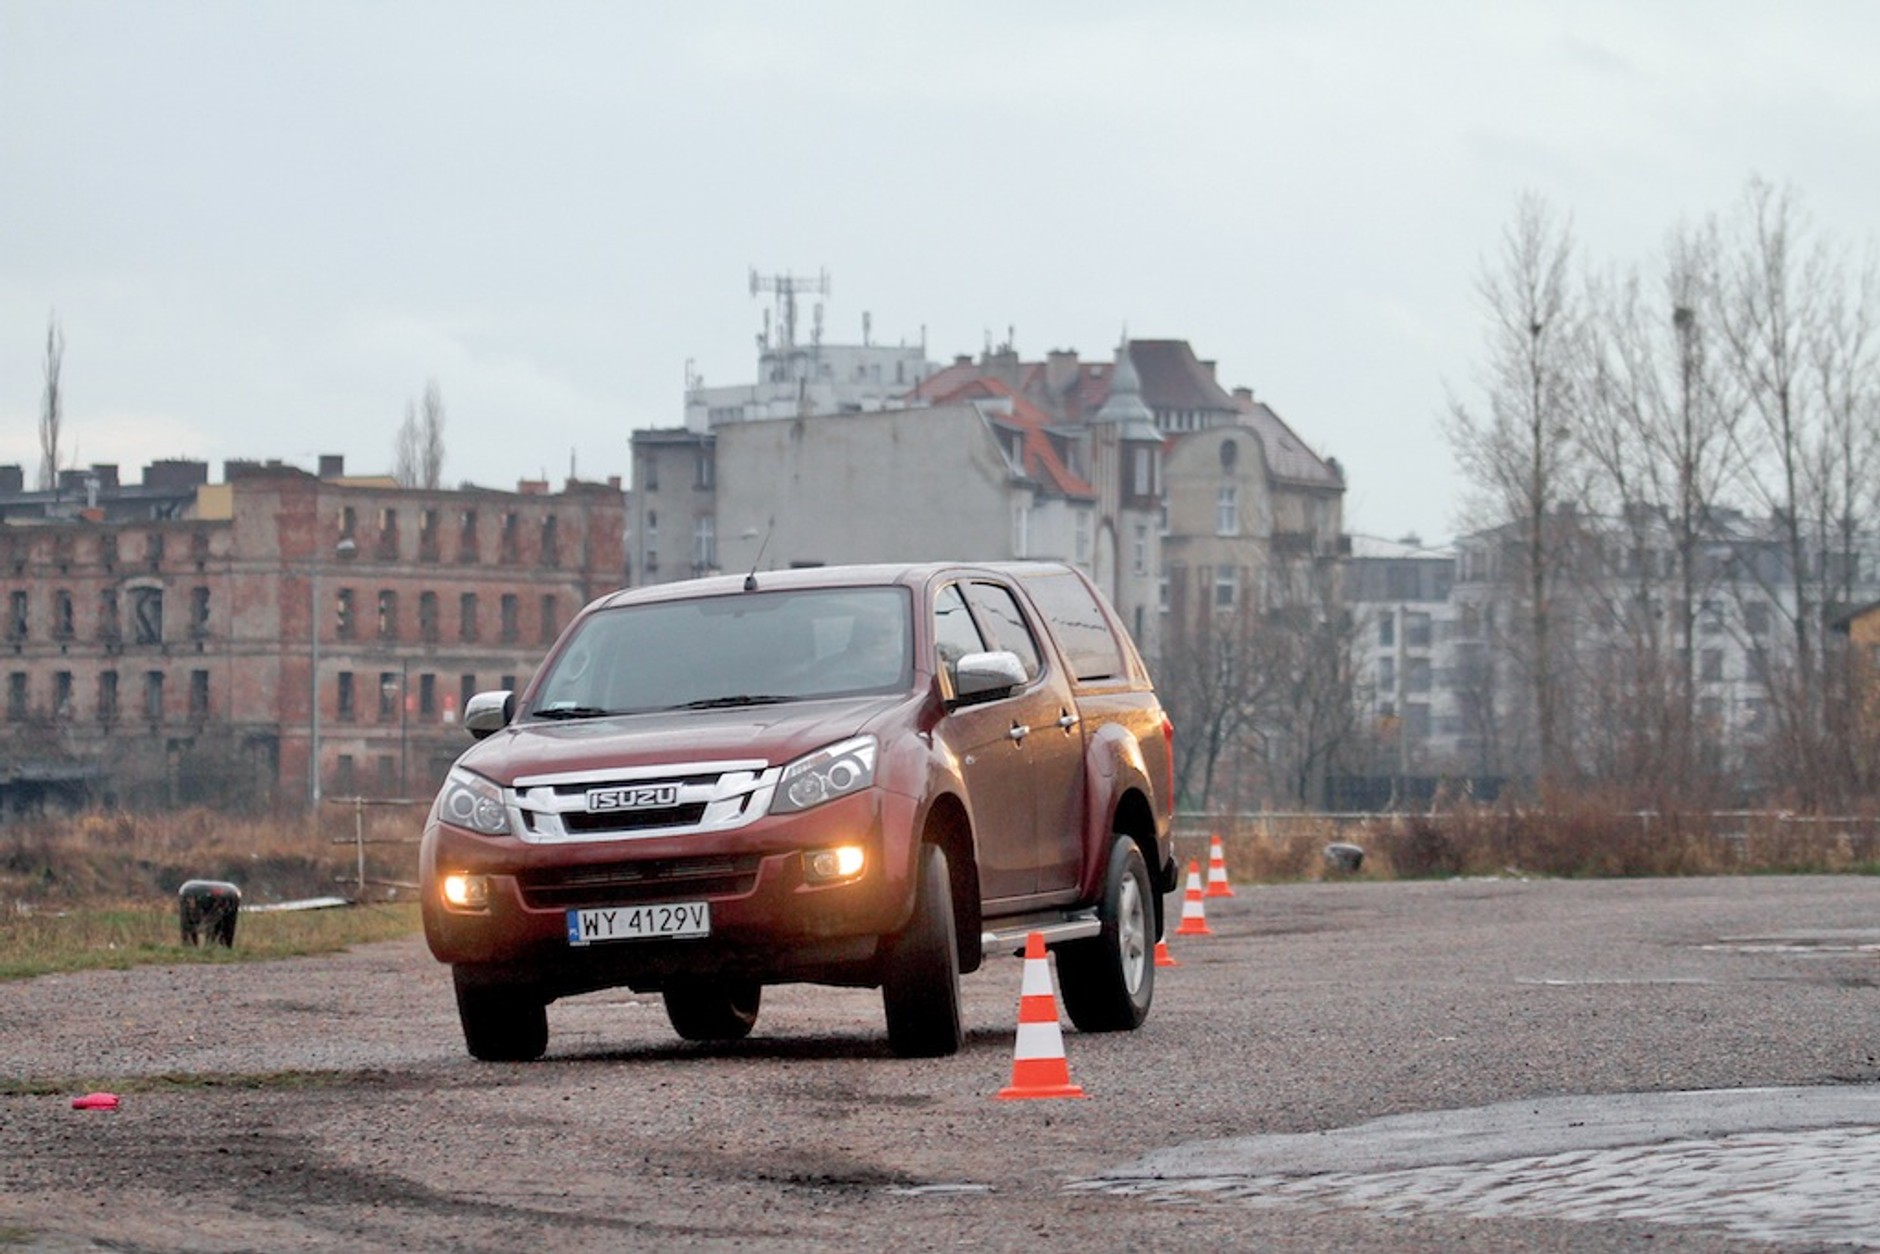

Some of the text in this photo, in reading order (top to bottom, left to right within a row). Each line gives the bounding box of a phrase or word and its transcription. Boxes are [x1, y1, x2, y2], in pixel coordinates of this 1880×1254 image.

[591, 787, 675, 809] ISUZU
[583, 905, 704, 936] WY 4129V
